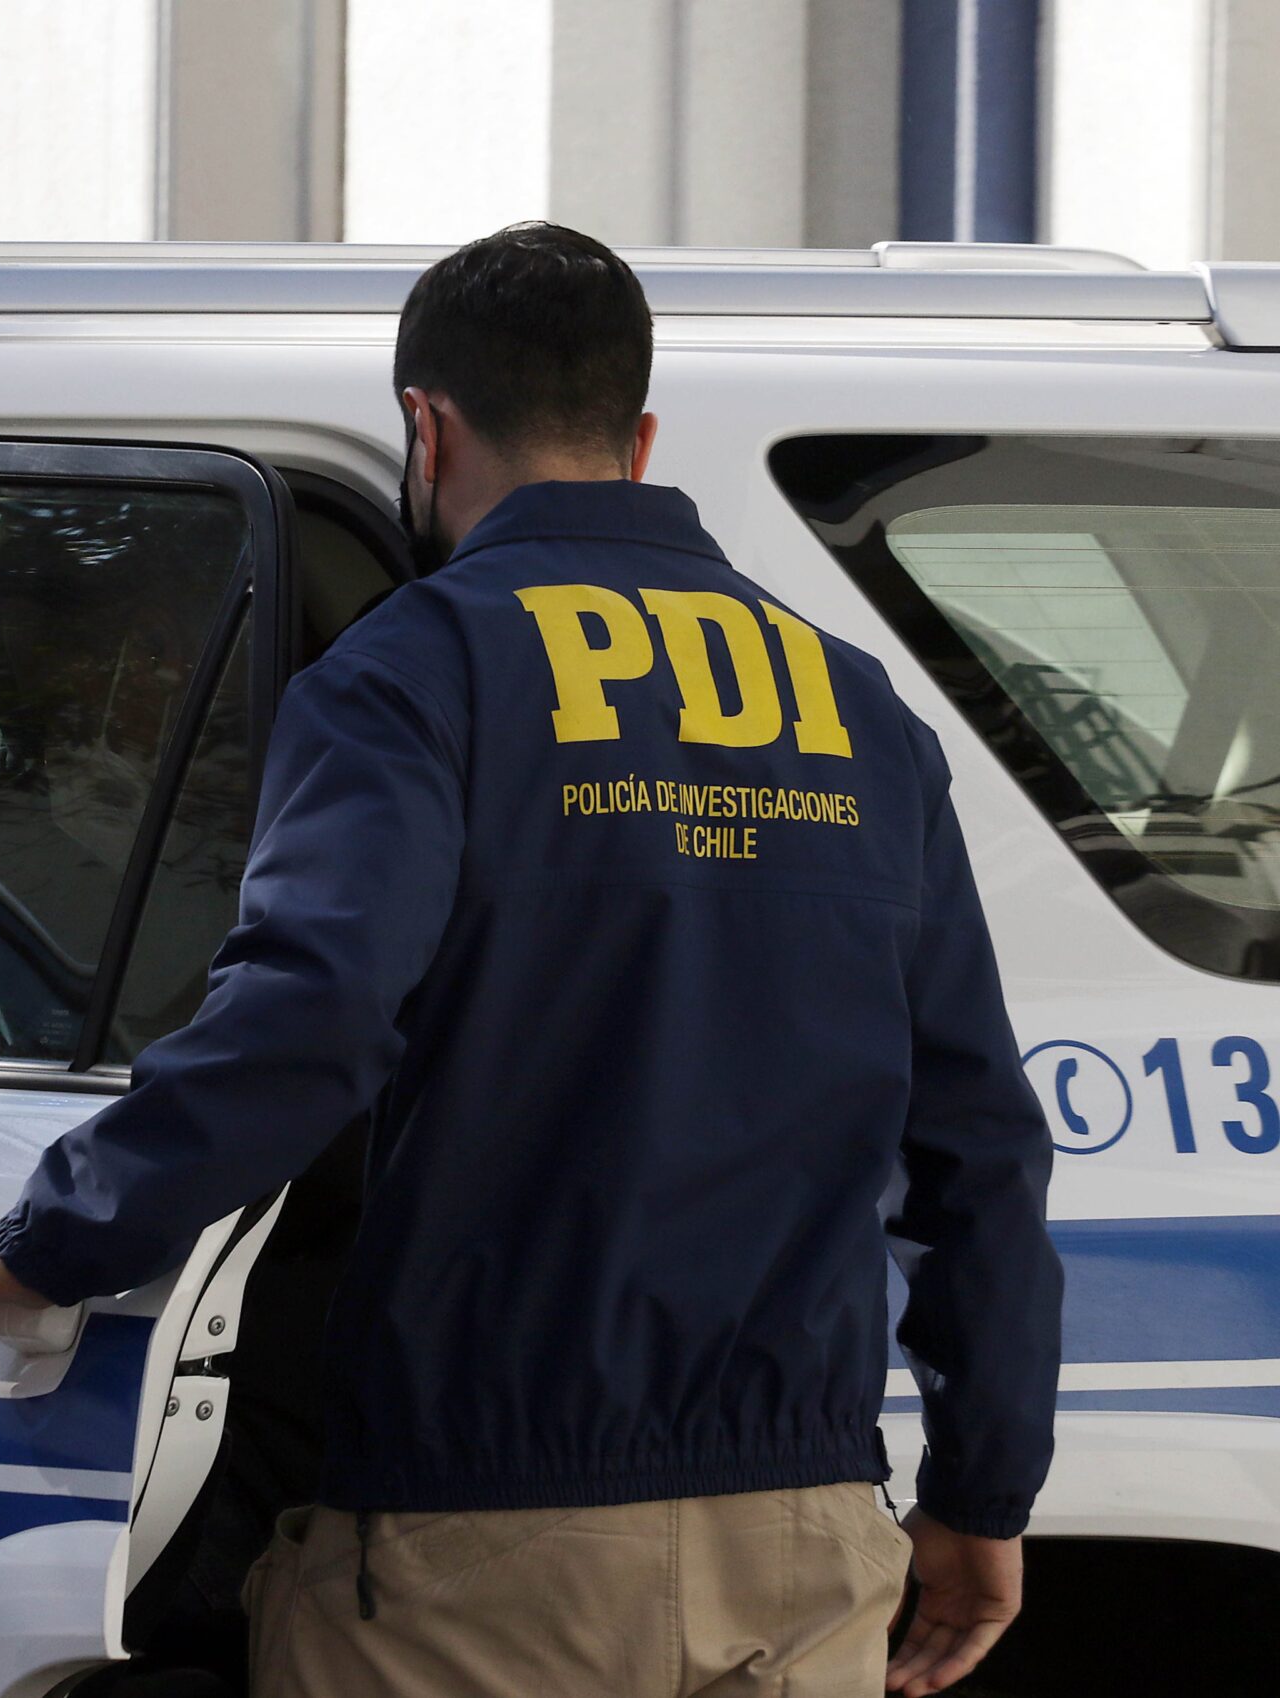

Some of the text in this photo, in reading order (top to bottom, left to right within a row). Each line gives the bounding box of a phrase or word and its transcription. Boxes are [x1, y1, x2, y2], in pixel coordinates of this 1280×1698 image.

[513, 584, 853, 758] PDI
[563, 774, 859, 826] POLICÍA DE INVESTIGACIONES
[675, 822, 757, 859] DE CHILE
[1142, 1036, 1280, 1154] 13
